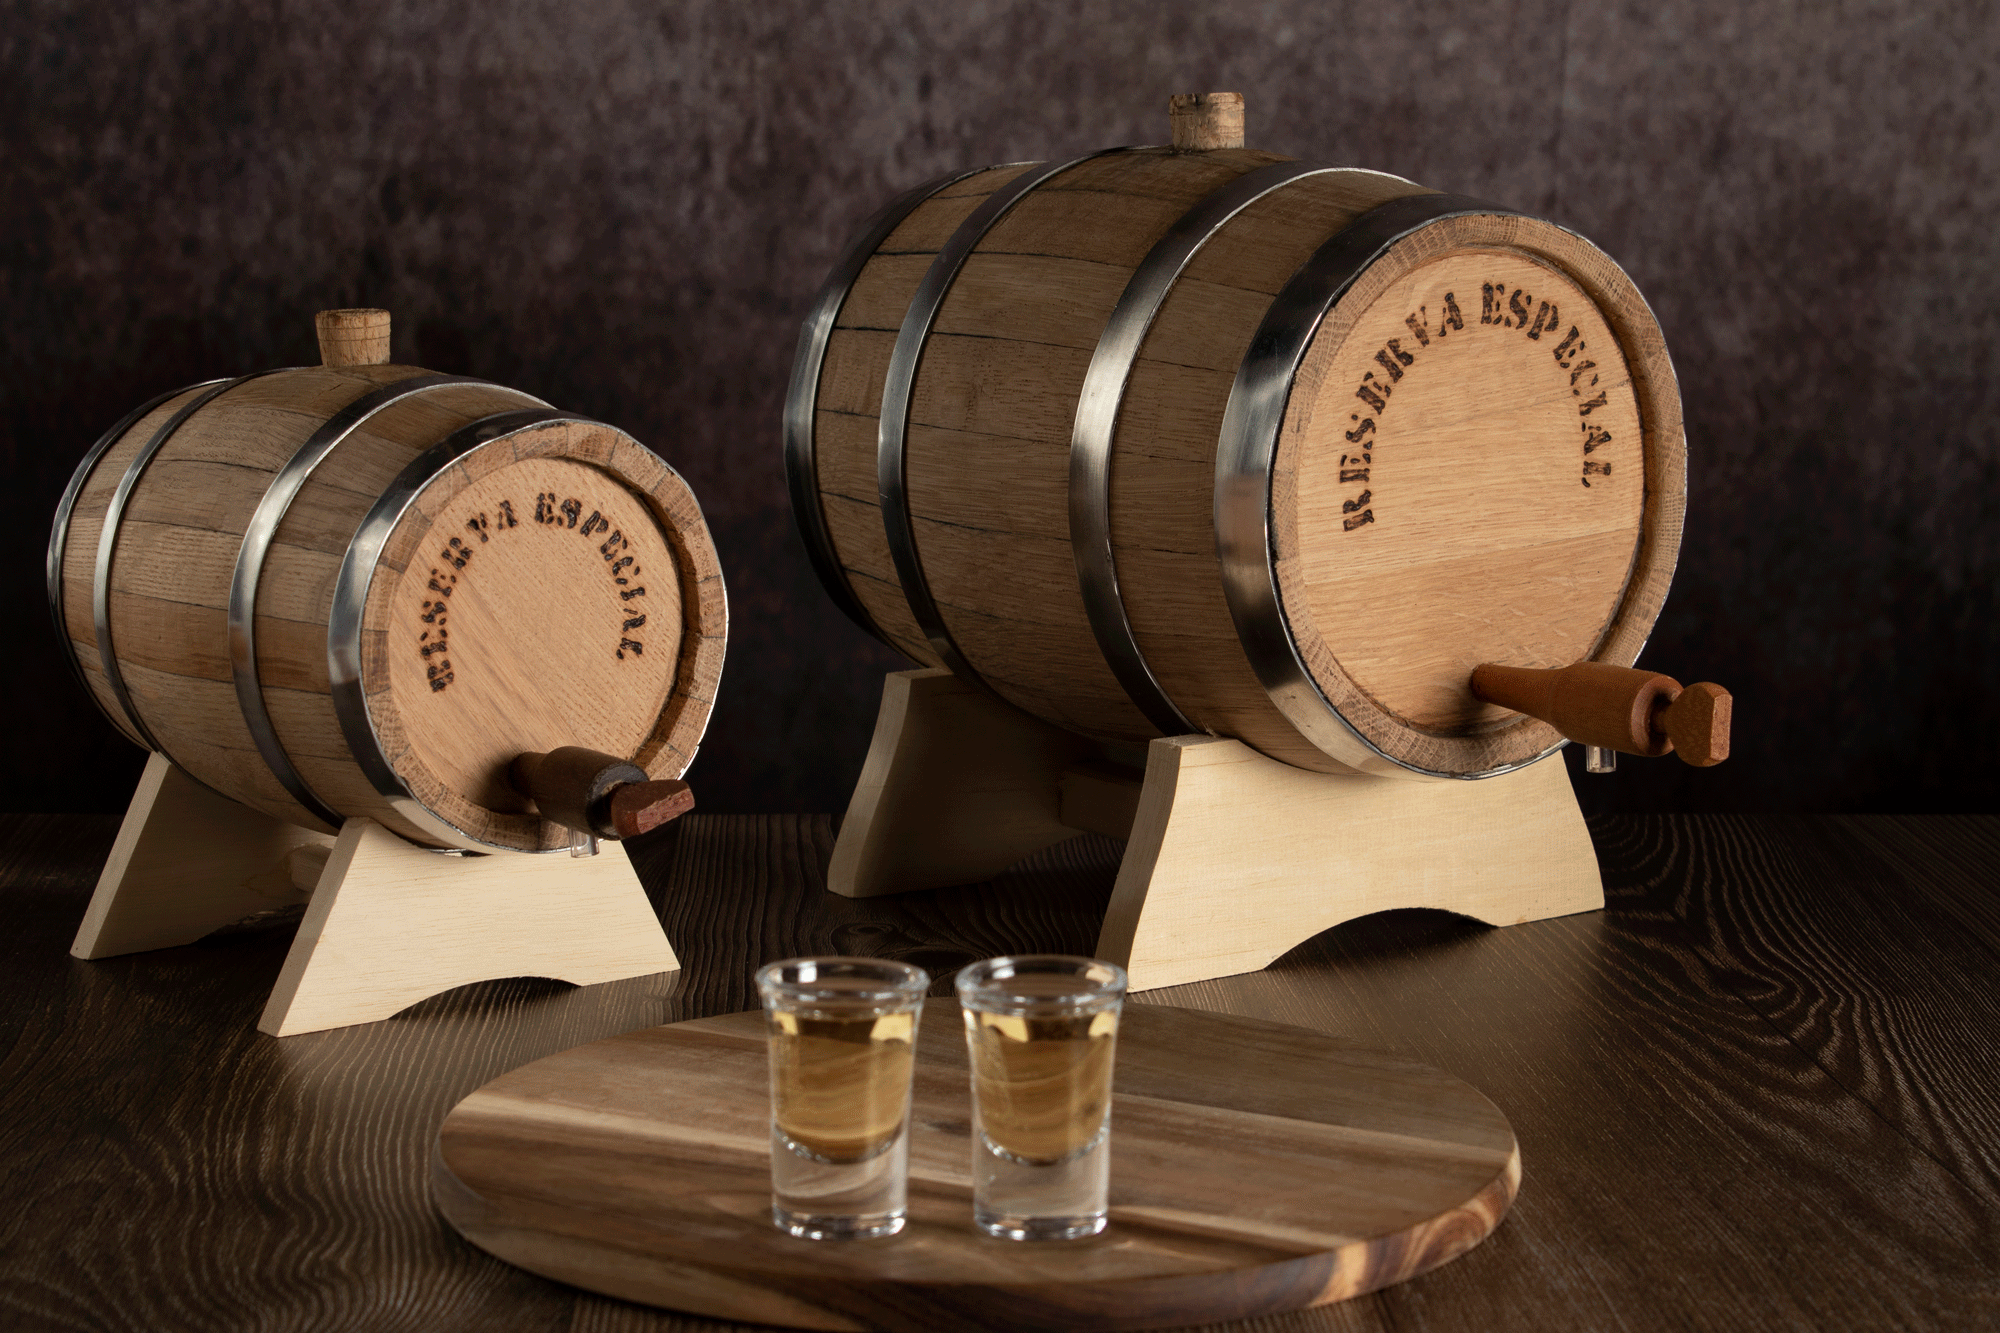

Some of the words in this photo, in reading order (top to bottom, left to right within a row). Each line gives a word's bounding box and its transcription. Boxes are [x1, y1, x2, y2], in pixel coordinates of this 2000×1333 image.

[1339, 292, 1464, 532] RESERVA
[1481, 282, 1612, 488] ESPECIAL
[420, 500, 517, 692] RESERVA
[535, 492, 646, 660] ESPECIAL
